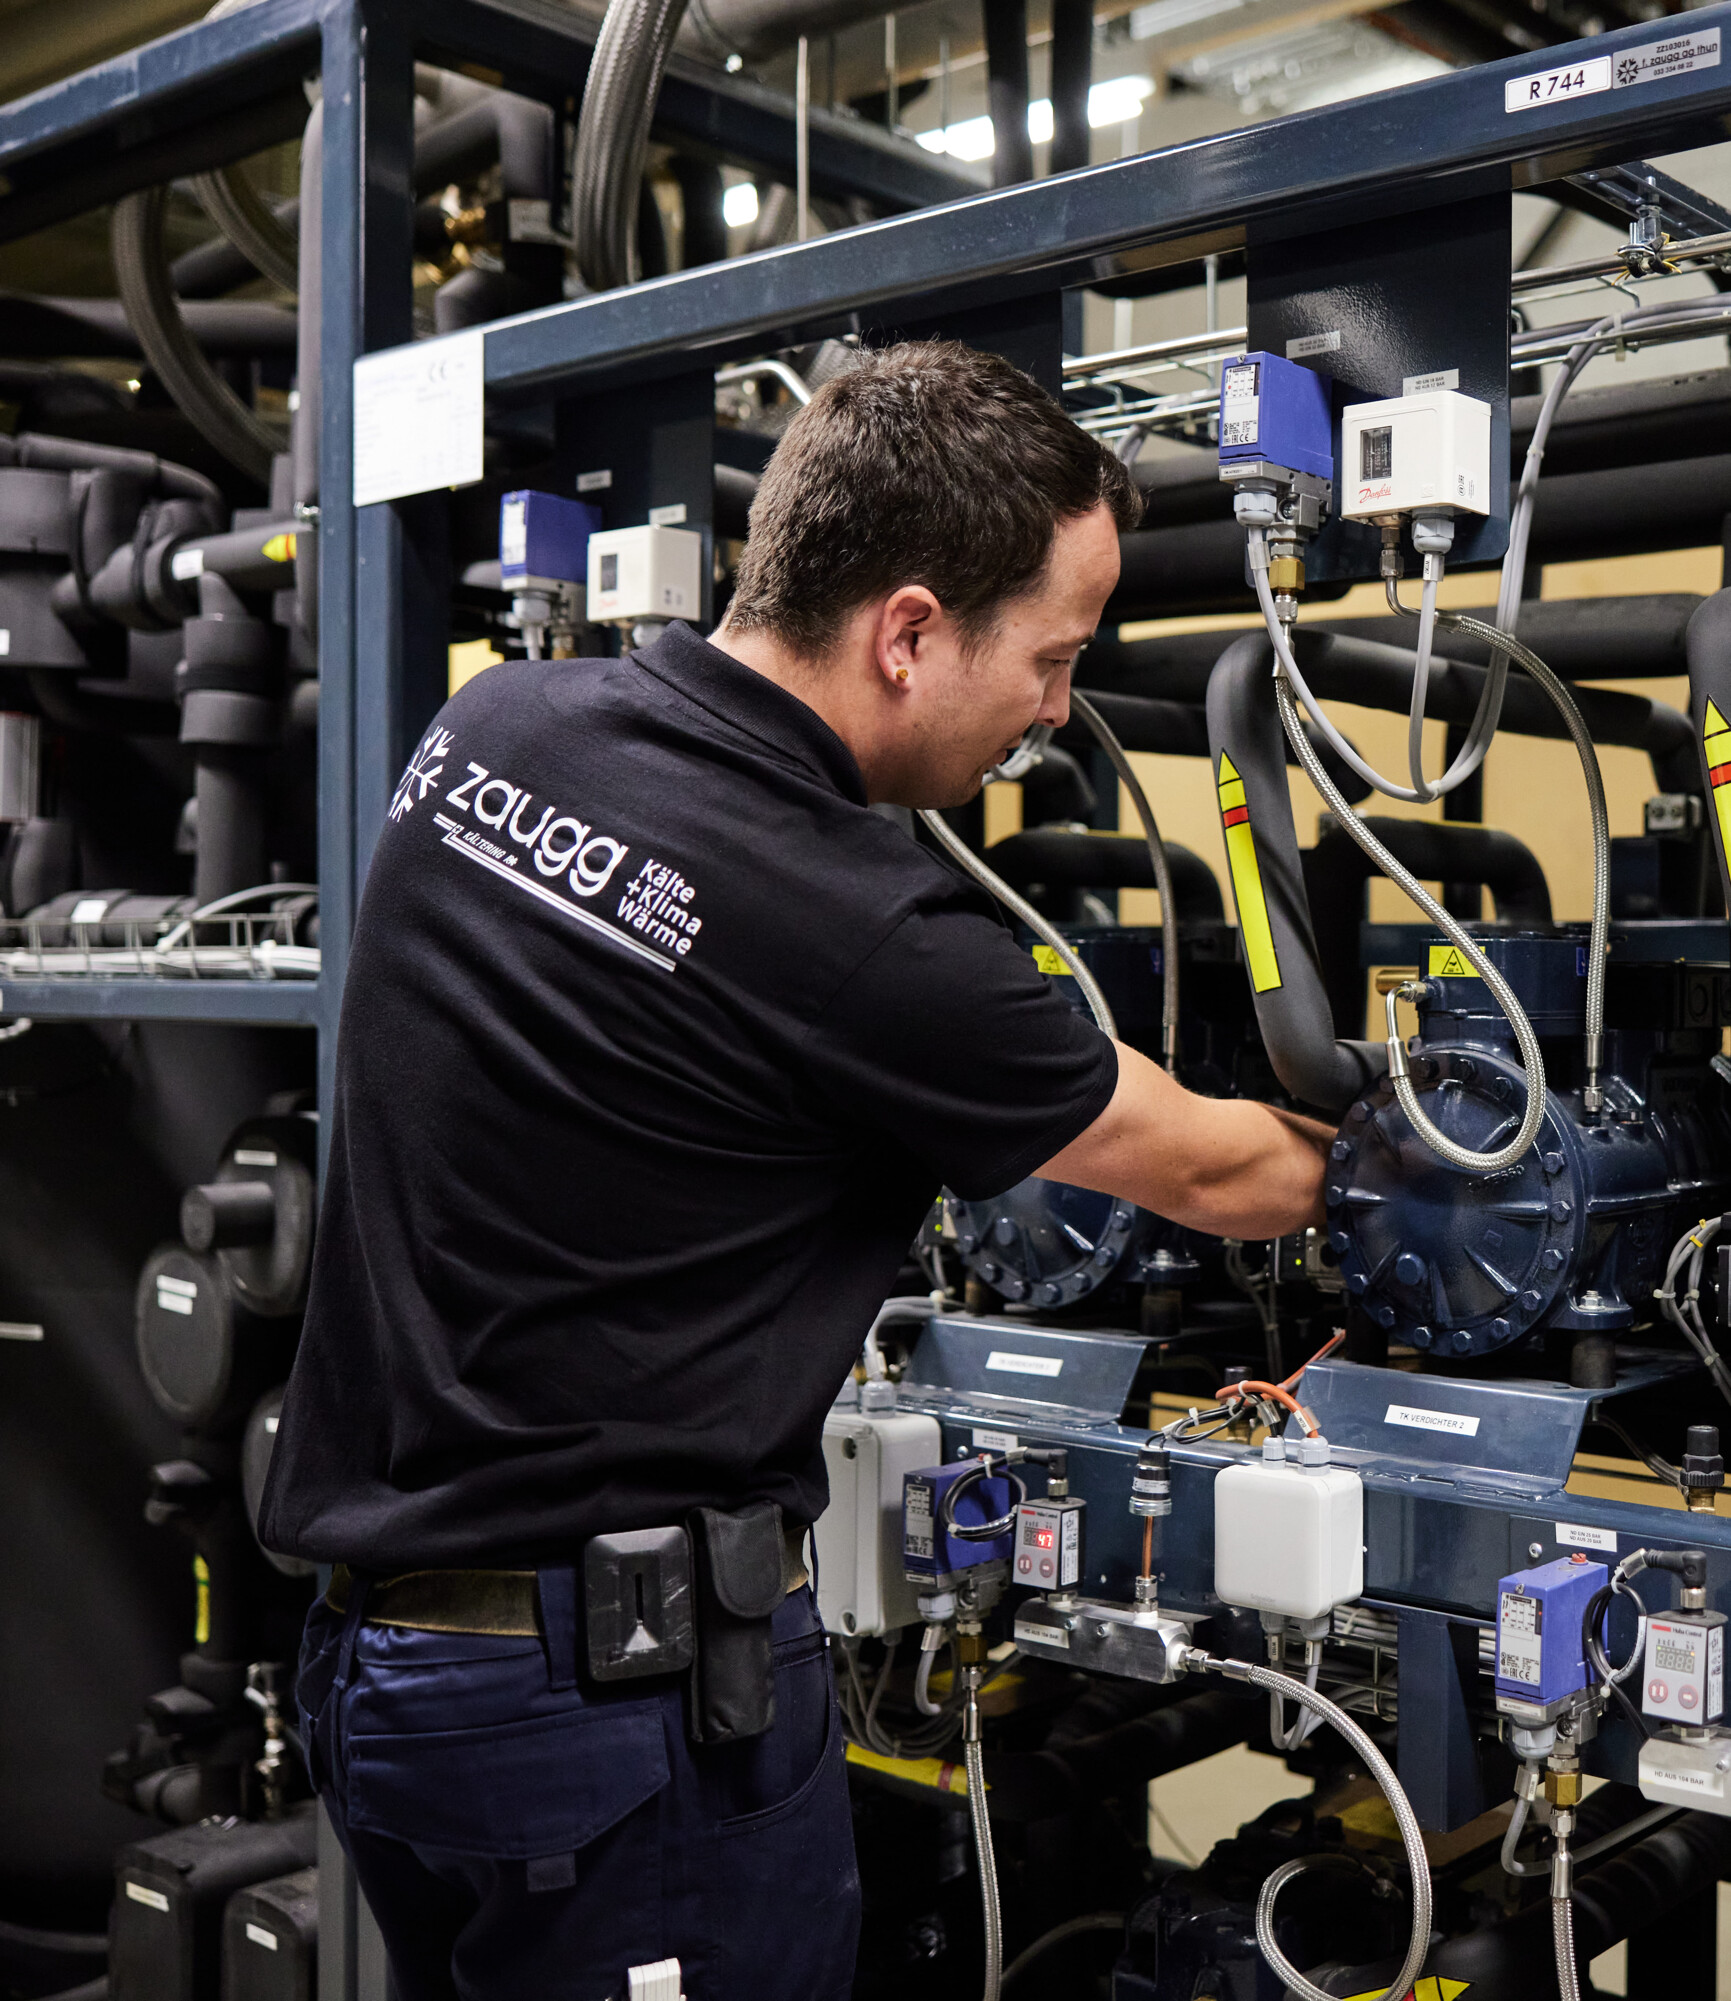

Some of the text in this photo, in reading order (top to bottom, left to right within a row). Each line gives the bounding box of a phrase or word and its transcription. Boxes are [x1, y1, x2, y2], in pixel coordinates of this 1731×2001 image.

[1650, 52, 1680, 64] zaugg
[1682, 48, 1695, 58] ag
[1697, 43, 1718, 55] thun
[1656, 39, 1691, 54] ZZ103016
[1529, 69, 1585, 100] R 744
[445, 761, 630, 897] zaugg
[462, 830, 507, 859] KÄLTERING
[638, 858, 696, 904] Kälte
[616, 895, 693, 956] Wärme
[1399, 1412, 1465, 1429] TK VERDICHTER 2
[1038, 1533, 1053, 1547] 47
[1654, 1770, 1663, 1778] HD
[1664, 1772, 1677, 1780] AUS
[1690, 1777, 1704, 1785] BAR
